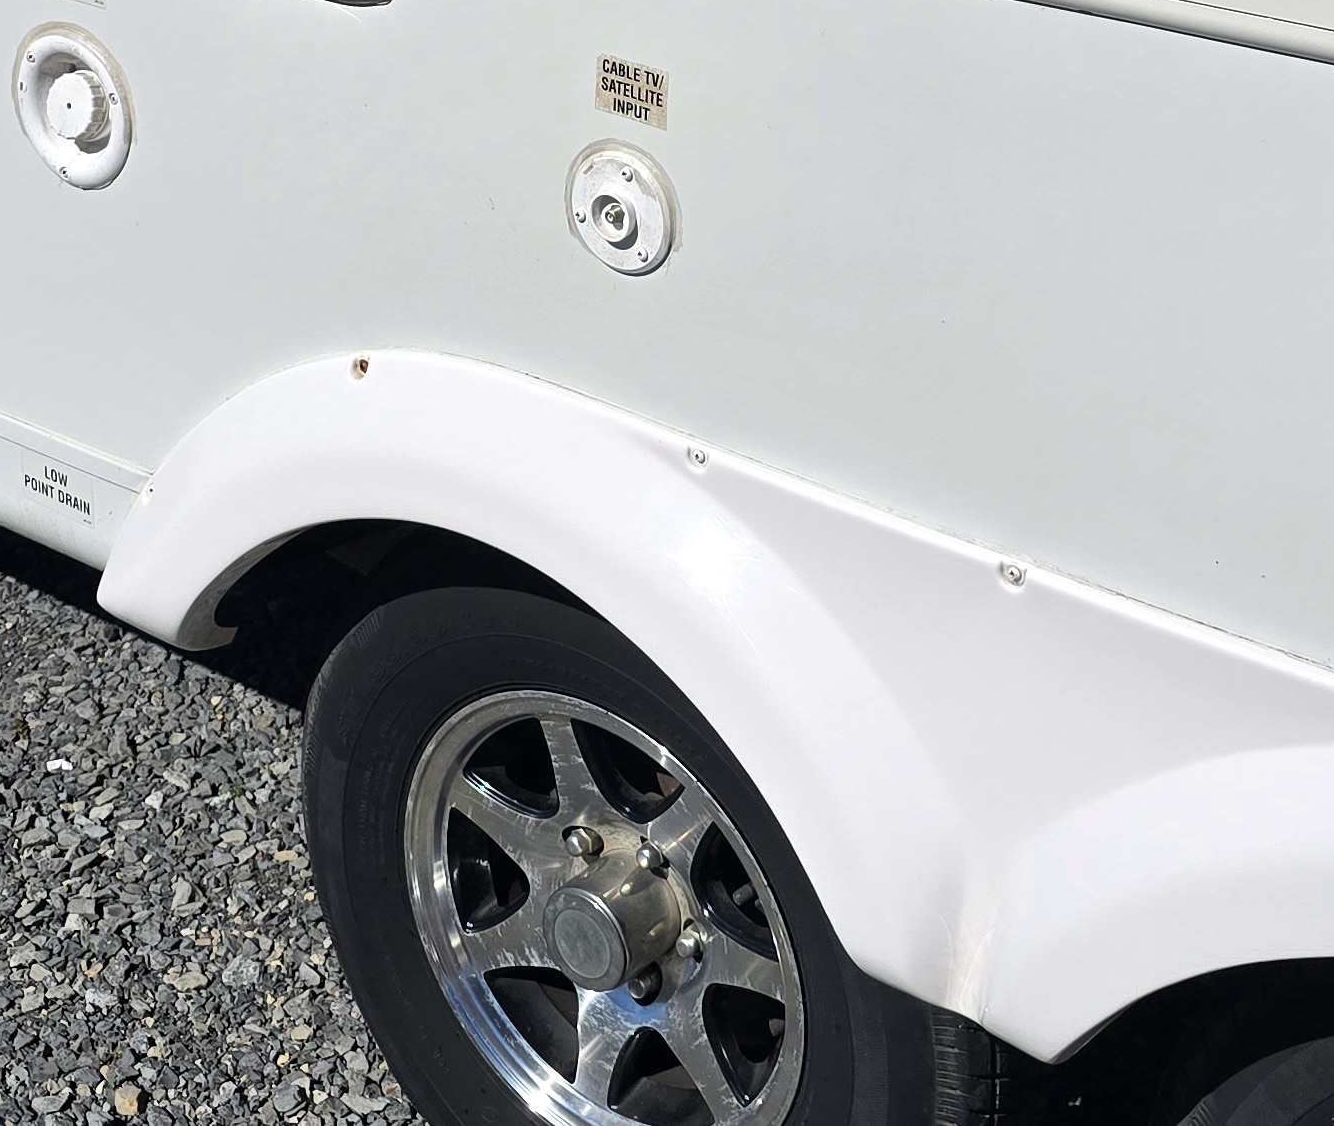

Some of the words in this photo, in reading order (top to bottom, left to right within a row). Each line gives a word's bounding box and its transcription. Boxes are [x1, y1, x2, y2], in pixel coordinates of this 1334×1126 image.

[602, 58, 641, 83] CABLE
[643, 70, 665, 91] TV/
[601, 76, 664, 108] SATELLITE
[612, 97, 651, 121] INPUT
[44, 465, 68, 487] LOW
[24, 474, 55, 499] POINT
[58, 489, 91, 516] DRAIN
